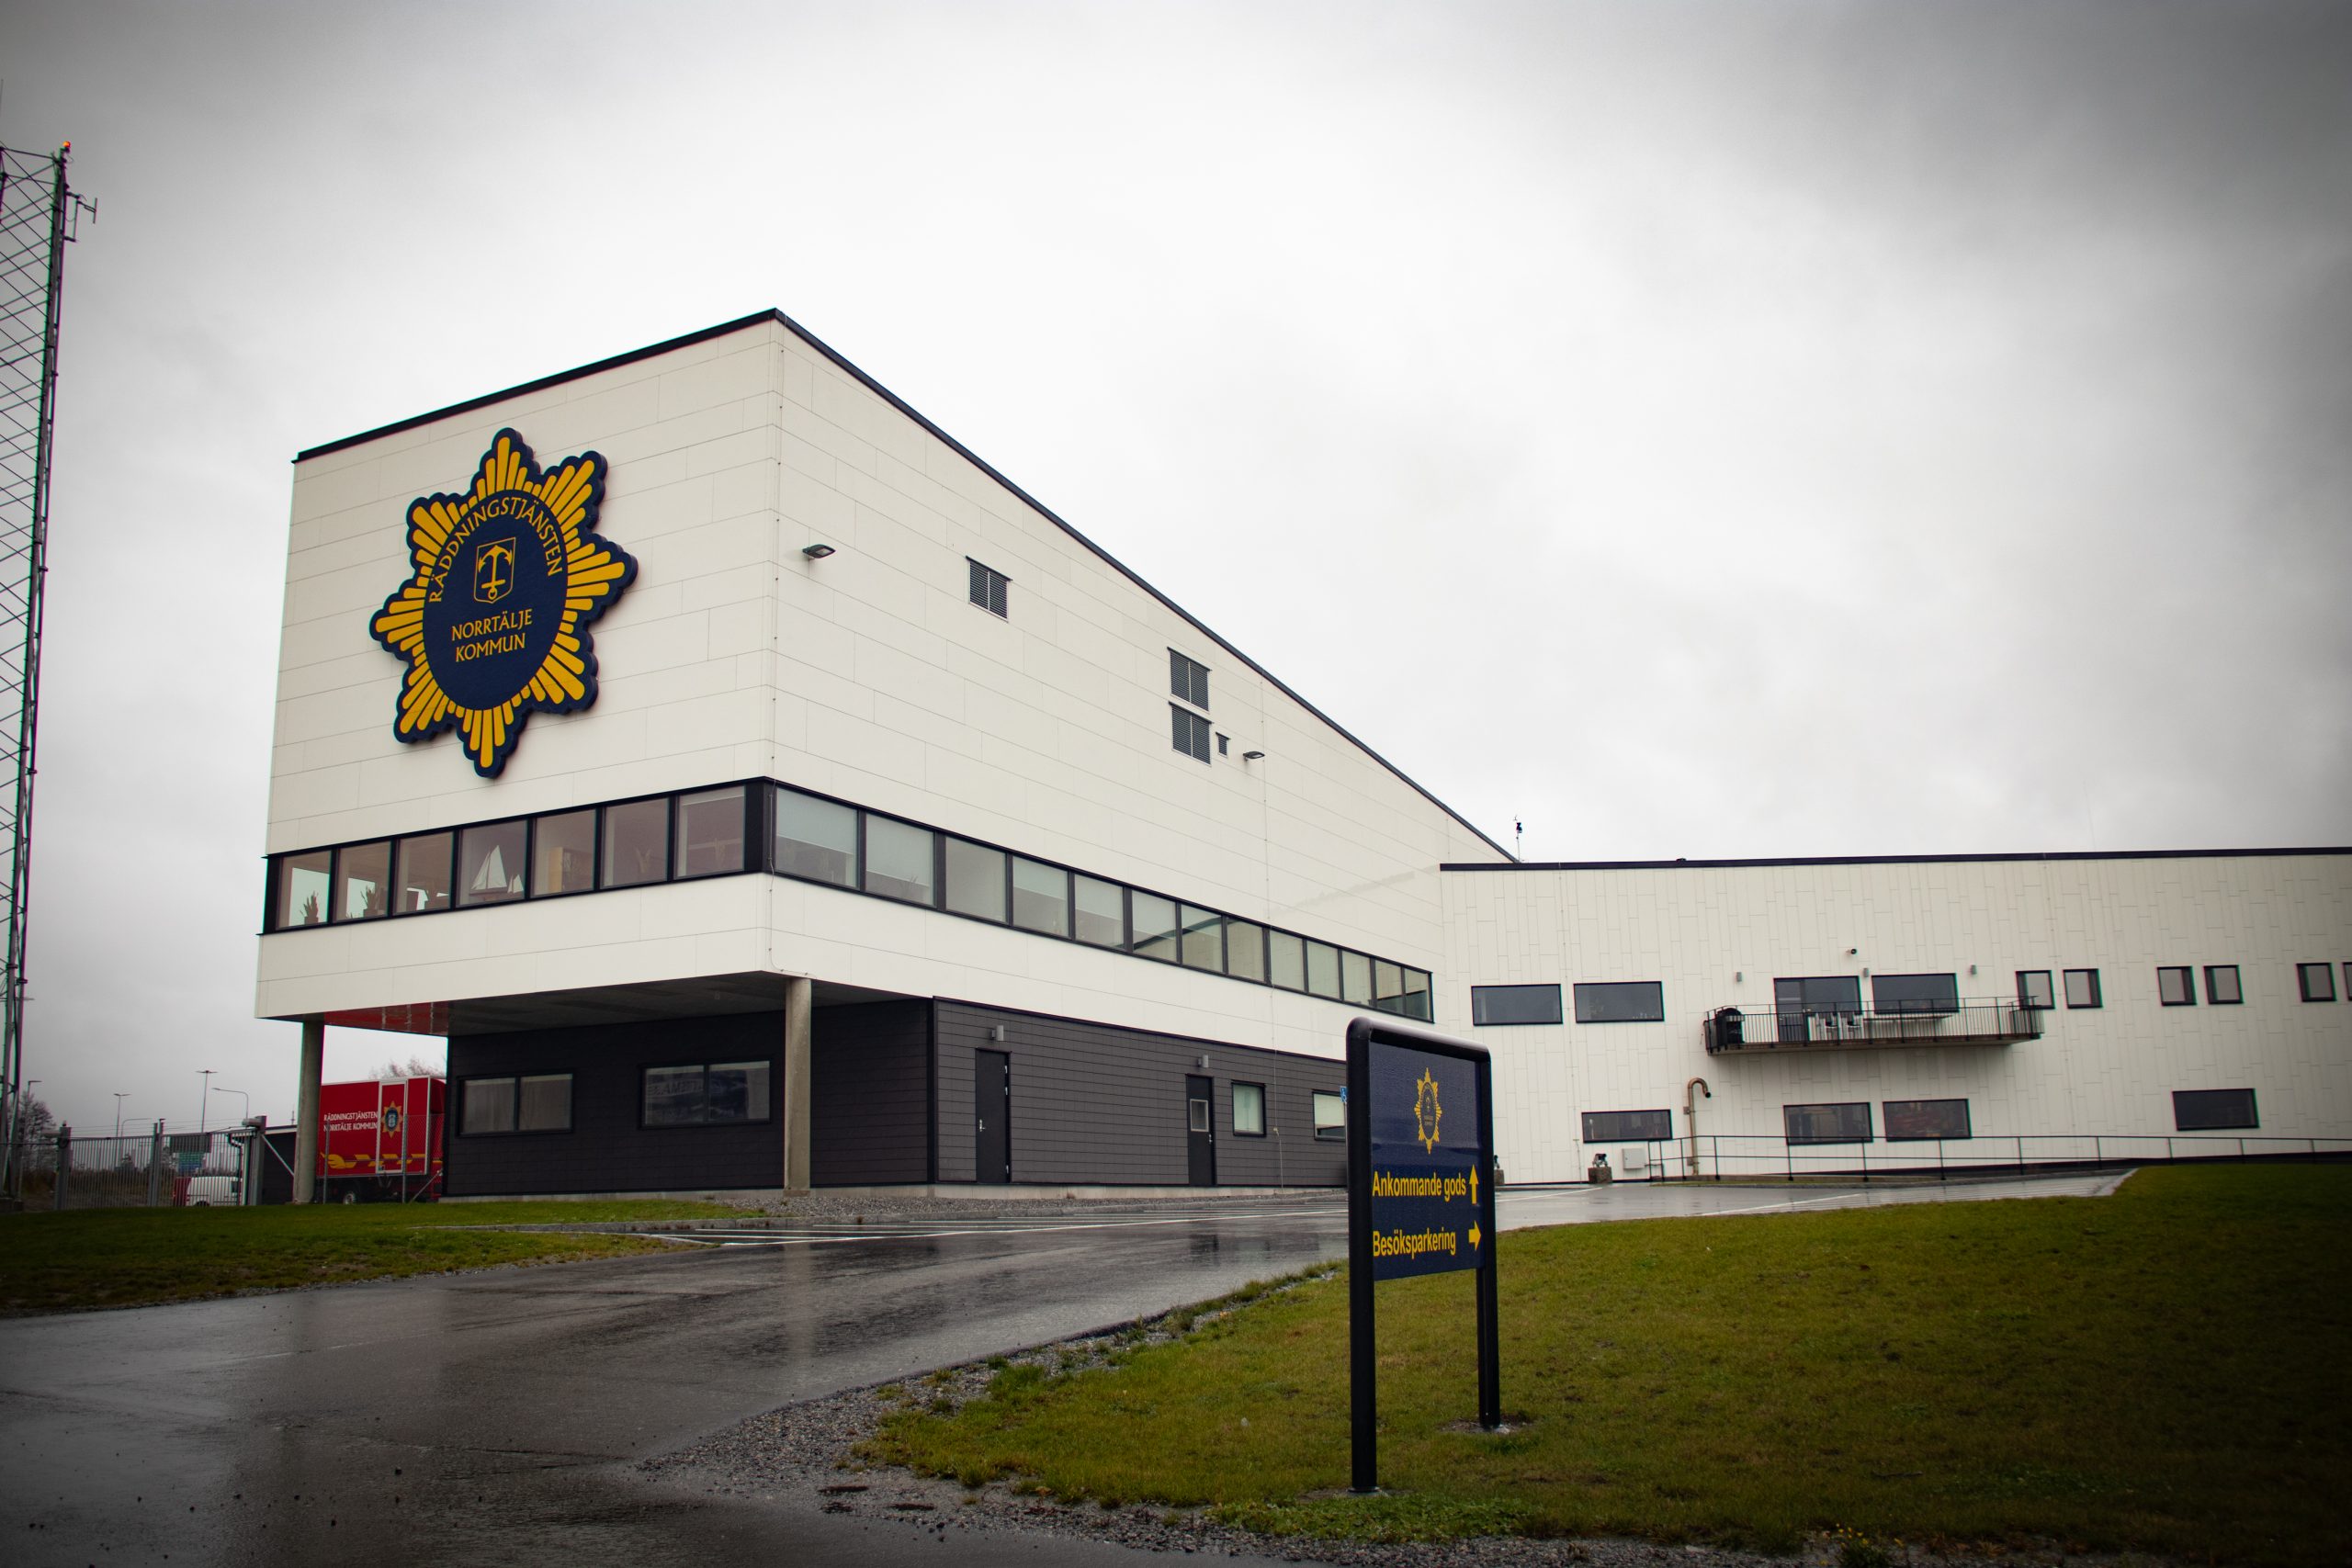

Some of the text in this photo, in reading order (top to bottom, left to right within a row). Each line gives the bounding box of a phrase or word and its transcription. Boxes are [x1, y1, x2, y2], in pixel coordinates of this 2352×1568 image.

[428, 496, 563, 603] RÄDDNINGSTJÄNSTEN
[451, 608, 533, 641] NORRTÄLJE
[456, 632, 526, 662] KOMMUN
[323, 1122, 352, 1132] NRRTÄLJE
[1372, 1170, 1466, 1202] Ankommande gods
[1373, 1226, 1456, 1259] Besöksparkering
